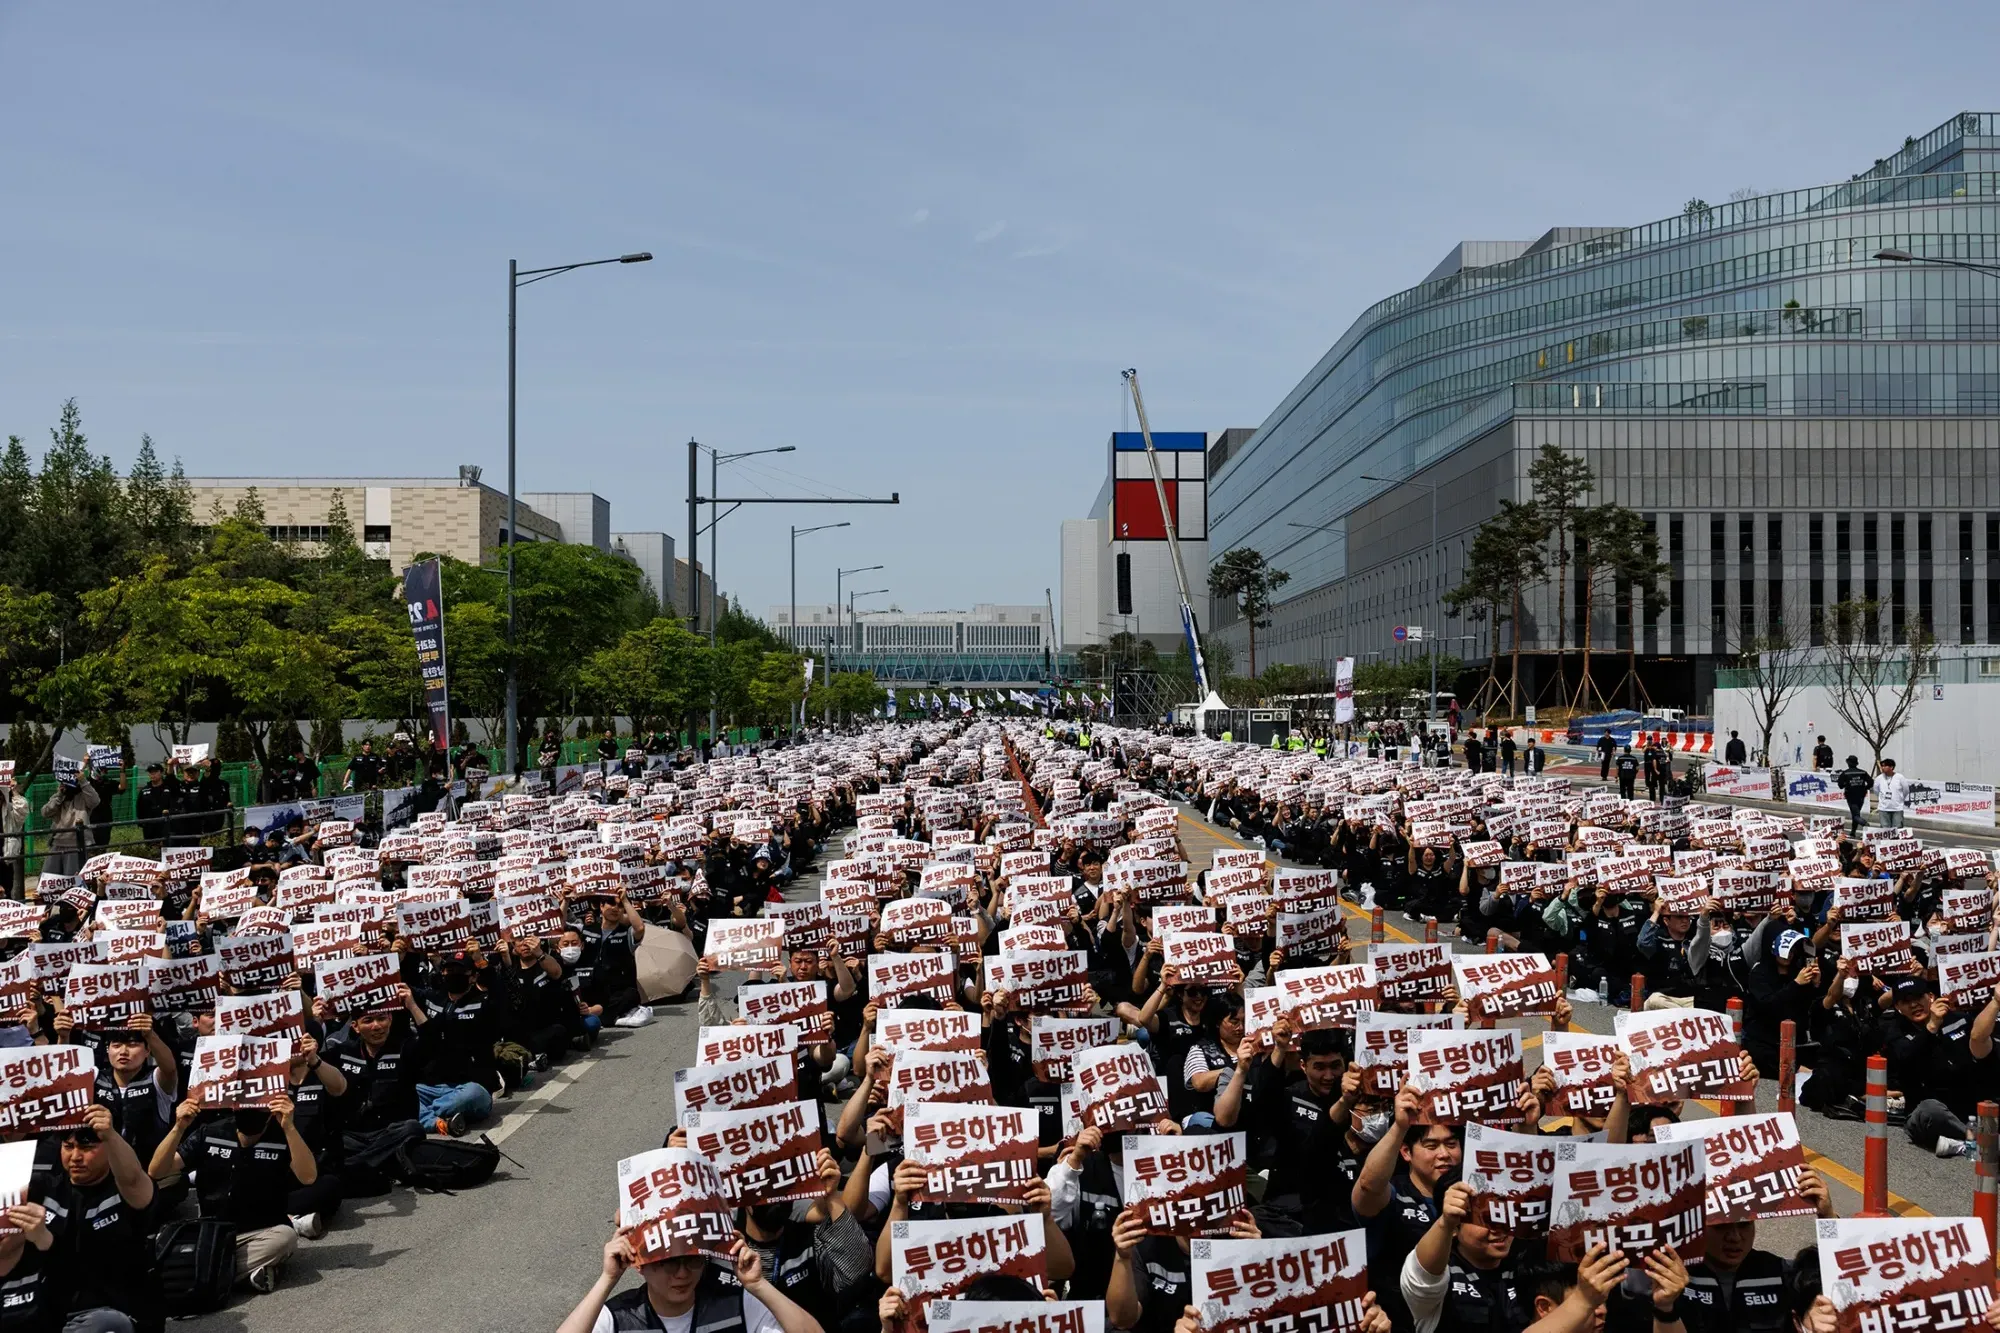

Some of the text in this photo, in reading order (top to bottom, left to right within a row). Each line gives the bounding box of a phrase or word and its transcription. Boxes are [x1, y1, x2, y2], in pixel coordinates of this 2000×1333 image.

[1590, 801, 1620, 813] 투명하게
[716, 811, 744, 823] 투명하게
[1138, 815, 1170, 829] 투명하게
[321, 823, 349, 835] 투명하게
[624, 826, 655, 839] 투명하게
[999, 825, 1027, 839] 투명하게
[1414, 823, 1447, 835] 투명하게
[1533, 825, 1566, 836] 투명하게
[1698, 821, 1733, 833] 투명하게
[663, 832, 698, 845] 투명하게
[935, 832, 971, 844] 투명하게
[166, 849, 206, 864] 투명하게
[580, 845, 614, 858] 투명하게
[667, 848, 699, 859] 바꾸고!!!
[1466, 842, 1498, 856] 투명하게
[1750, 841, 1787, 856] 투명하게
[1880, 841, 1918, 857] 투명하게
[1950, 851, 1982, 864] 투명하게
[114, 860, 157, 870] 투명하게
[570, 861, 614, 878] 투명하게
[830, 860, 872, 877] 투명하게
[1004, 853, 1045, 871] 투명하게
[1217, 852, 1260, 868] 투명하게
[1600, 859, 1642, 875] 투명하게
[1754, 858, 1790, 870] 바꾸고!!!
[1793, 860, 1834, 874] 투명하게
[1886, 856, 1922, 871] 바꾸고!!!
[170, 865, 210, 880] 바꾸고!!!
[924, 865, 968, 883] 투명하게
[1132, 864, 1181, 881] 투명하게
[1210, 870, 1253, 889] 투명하게
[1279, 872, 1332, 892] 투명하게
[40, 878, 76, 890] 투명하게
[109, 887, 143, 898] 투명하게
[282, 882, 328, 900] 투명하게
[499, 875, 540, 893] 투명하게
[575, 880, 618, 894] 바꾸고!!!
[824, 884, 870, 900] 투명하게
[1017, 879, 1065, 897] 투명하게
[1139, 885, 1185, 899] 바꾸고!!!
[1609, 875, 1650, 891] 바꾸고!!!
[1660, 879, 1700, 895] 투명하게
[1718, 876, 1771, 891] 투명하게
[1839, 883, 1889, 901] 투명하게
[206, 887, 250, 906] 투명하게
[1285, 896, 1337, 913] 바꾸고!!!
[1668, 896, 1707, 913] 바꾸고!!!
[1724, 894, 1773, 909] 바꾸고!!!
[1948, 892, 1991, 912] 투명하게
[241, 908, 285, 926] 투명하게
[404, 901, 462, 928] 투명하게
[887, 900, 944, 923] 투명하게
[1157, 909, 1215, 929] 투명하게
[1844, 901, 1893, 918] 바꾸고!!!
[511, 917, 562, 938] 바꾸고!!!
[712, 922, 775, 945] 투명하게
[894, 924, 948, 943] 바꾸고!!!
[1282, 910, 1336, 939] 투명하게
[111, 934, 156, 951] 명하게
[293, 925, 351, 948] 투명하게
[412, 927, 470, 950] 바꾸고!!!
[1005, 929, 1057, 950] 투명하게
[1289, 932, 1341, 957] 바꾸고!!!
[1848, 924, 1904, 950] 투명하게
[220, 937, 284, 964] 투명하게
[1170, 935, 1228, 958] 투명하게
[34, 944, 98, 971] 투명하게
[718, 947, 779, 966] 바꾸고!!!
[1374, 946, 1443, 974] 투명하게
[1857, 949, 1912, 973] 바꾸고!!!
[231, 963, 292, 986] 바꾸고!!!
[322, 956, 390, 990] 투명하게
[875, 955, 944, 986] 투명하게
[1012, 953, 1079, 983] 투명하게
[1179, 960, 1234, 980] 바꾸고!!!
[1463, 955, 1539, 986] 투명하게
[68, 969, 140, 997] 투명하게
[1284, 966, 1367, 997] 투명하게
[1383, 974, 1449, 999] 바꾸고!!!
[152, 986, 218, 1009] 바꾸고!!!
[334, 983, 397, 1013] 바꾸고!!!
[746, 984, 816, 1018] 투명하게
[1019, 984, 1083, 1008] 바꾸고!!!
[1482, 982, 1556, 1013] 바꾸고!!!
[72, 1000, 144, 1026] 바꾸고!!!
[220, 997, 292, 1031] 투명하게
[884, 1014, 969, 1044] 투명하게
[1038, 1020, 1111, 1050] 투명하게
[1628, 1015, 1728, 1058] 투명하게
[199, 1040, 278, 1071] 투명하게
[704, 1028, 786, 1064] 투명하게
[1418, 1033, 1516, 1078] 투명하게
[0, 1048, 80, 1090] 명하게
[376, 1061, 396, 1070] SELU
[1080, 1052, 1150, 1093] 투명하게
[897, 1059, 979, 1094] 투명하게
[1649, 1057, 1742, 1094] 바꾸고!!!
[127, 1088, 149, 1098] SELU
[204, 1074, 285, 1103] 바꾸고!!!
[685, 1060, 780, 1111] 투명하게
[297, 1093, 318, 1102] SELU
[1434, 1078, 1521, 1118] 바꾸고!!!
[1093, 1091, 1167, 1126] 바꾸고!!!
[1296, 1106, 1318, 1121] 투쟁
[697, 1106, 804, 1161] 투명하게
[914, 1112, 1023, 1153] 투명하게
[1705, 1117, 1784, 1167] 명하게
[207, 1145, 232, 1159] 투쟁
[254, 1151, 279, 1160] SELU
[1134, 1137, 1236, 1186] 투명하게
[721, 1151, 818, 1199] 바꾸고!!!
[927, 1158, 1033, 1194] 바꾸고!!!
[1568, 1145, 1694, 1207] 투명하게
[1149, 1183, 1245, 1227] 바꾸고!!!
[93, 1212, 119, 1230] SELU
[643, 1212, 736, 1253] 바꾸고!!!
[1583, 1205, 1703, 1257] 바꾸고!!!
[904, 1219, 1030, 1281] 투명하게
[1834, 1222, 1972, 1287] 투명하게
[785, 1269, 809, 1287] SELU
[1206, 1237, 1349, 1306] 투명하게
[3, 1292, 34, 1308] SELU
[1682, 1287, 1713, 1304] 투쟁
[1745, 1294, 1777, 1306] SELU
[1859, 1285, 1990, 1333] 바꾸고!!!
